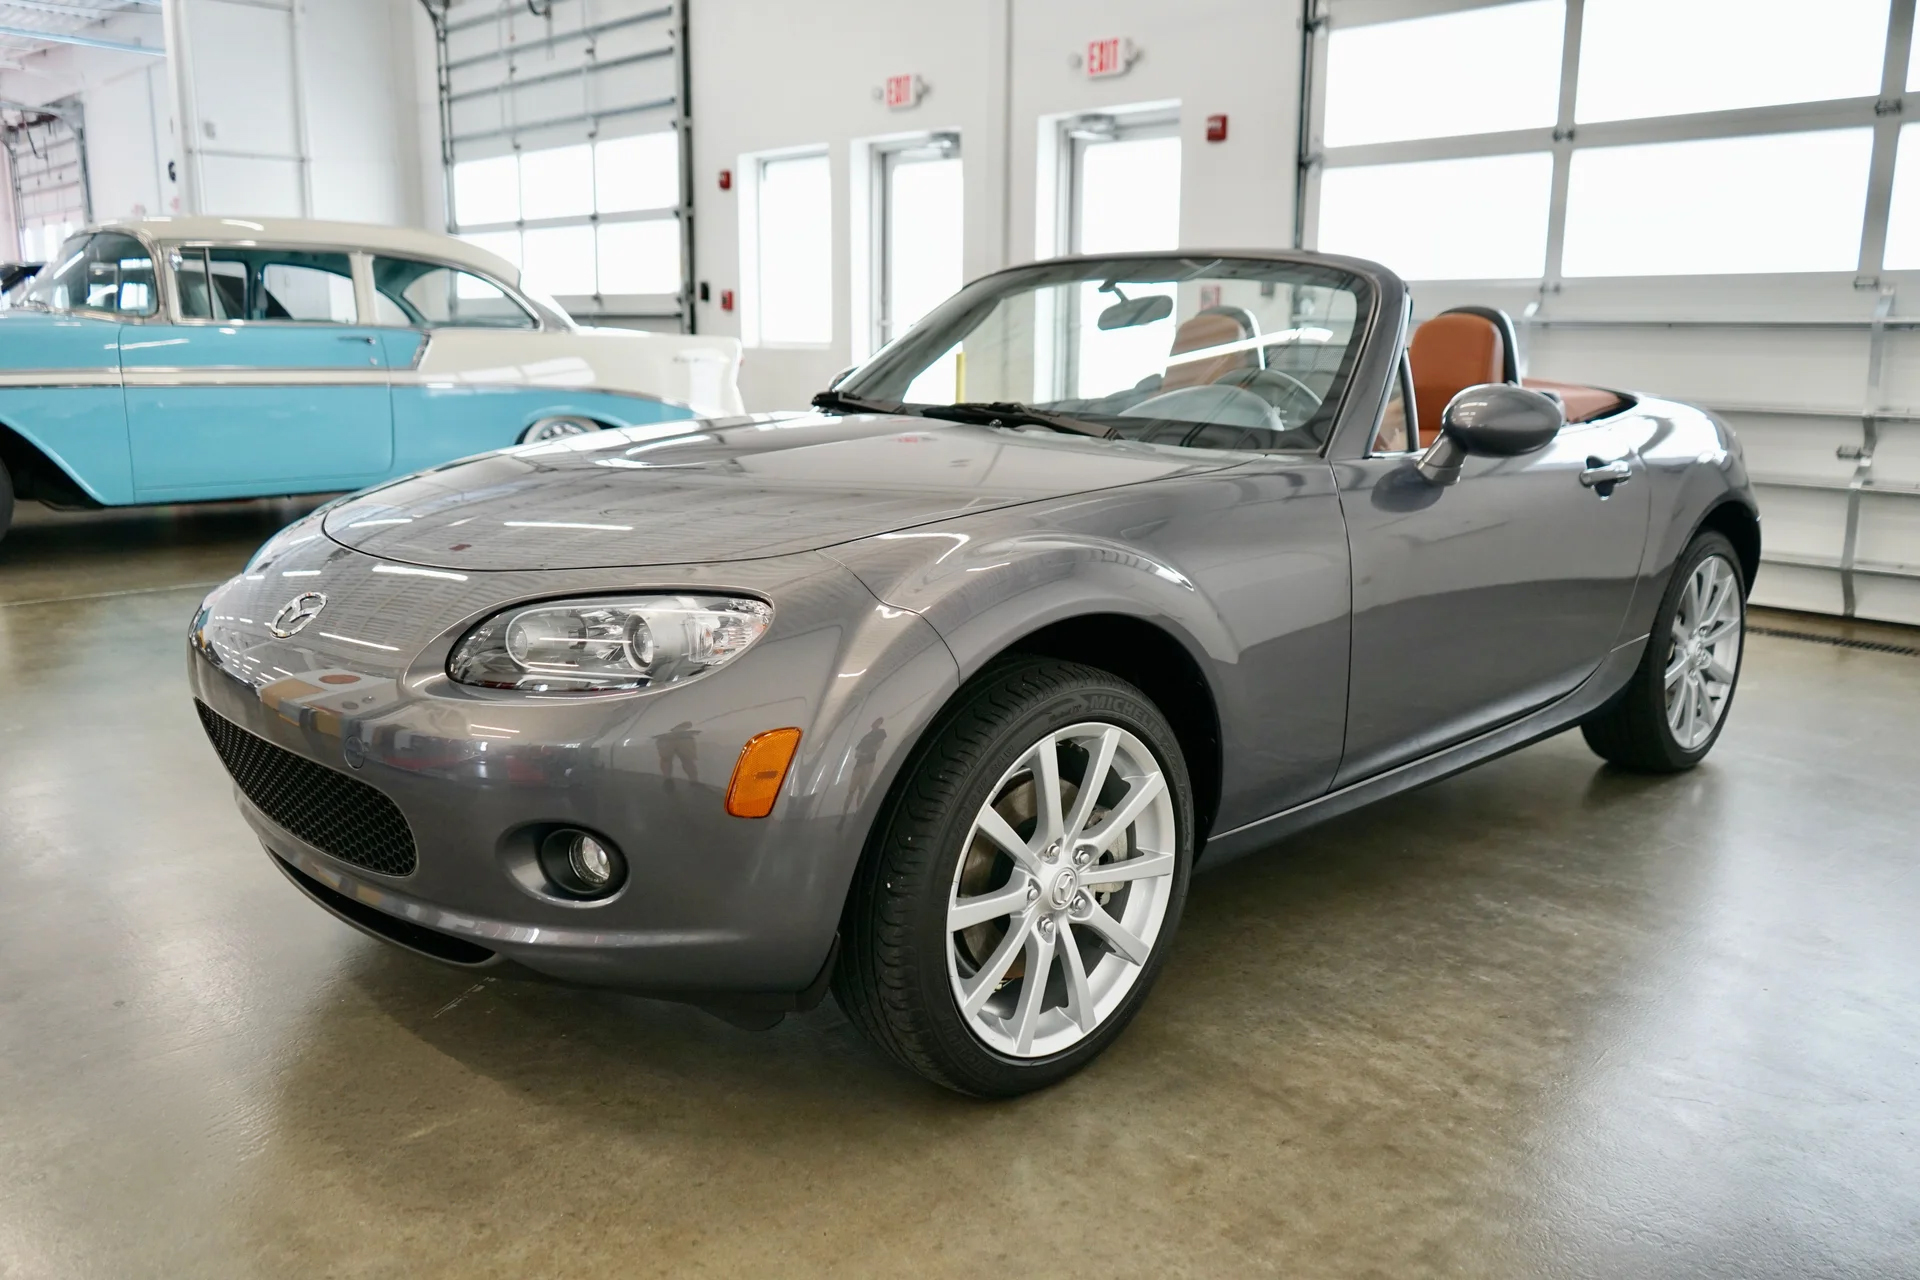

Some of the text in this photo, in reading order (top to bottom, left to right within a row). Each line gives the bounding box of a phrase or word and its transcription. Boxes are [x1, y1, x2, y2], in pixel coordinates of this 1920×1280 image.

[1089, 38, 1118, 75] EXIT
[887, 75, 911, 106] EXIT
[1090, 695, 1165, 740] MICHELIN
